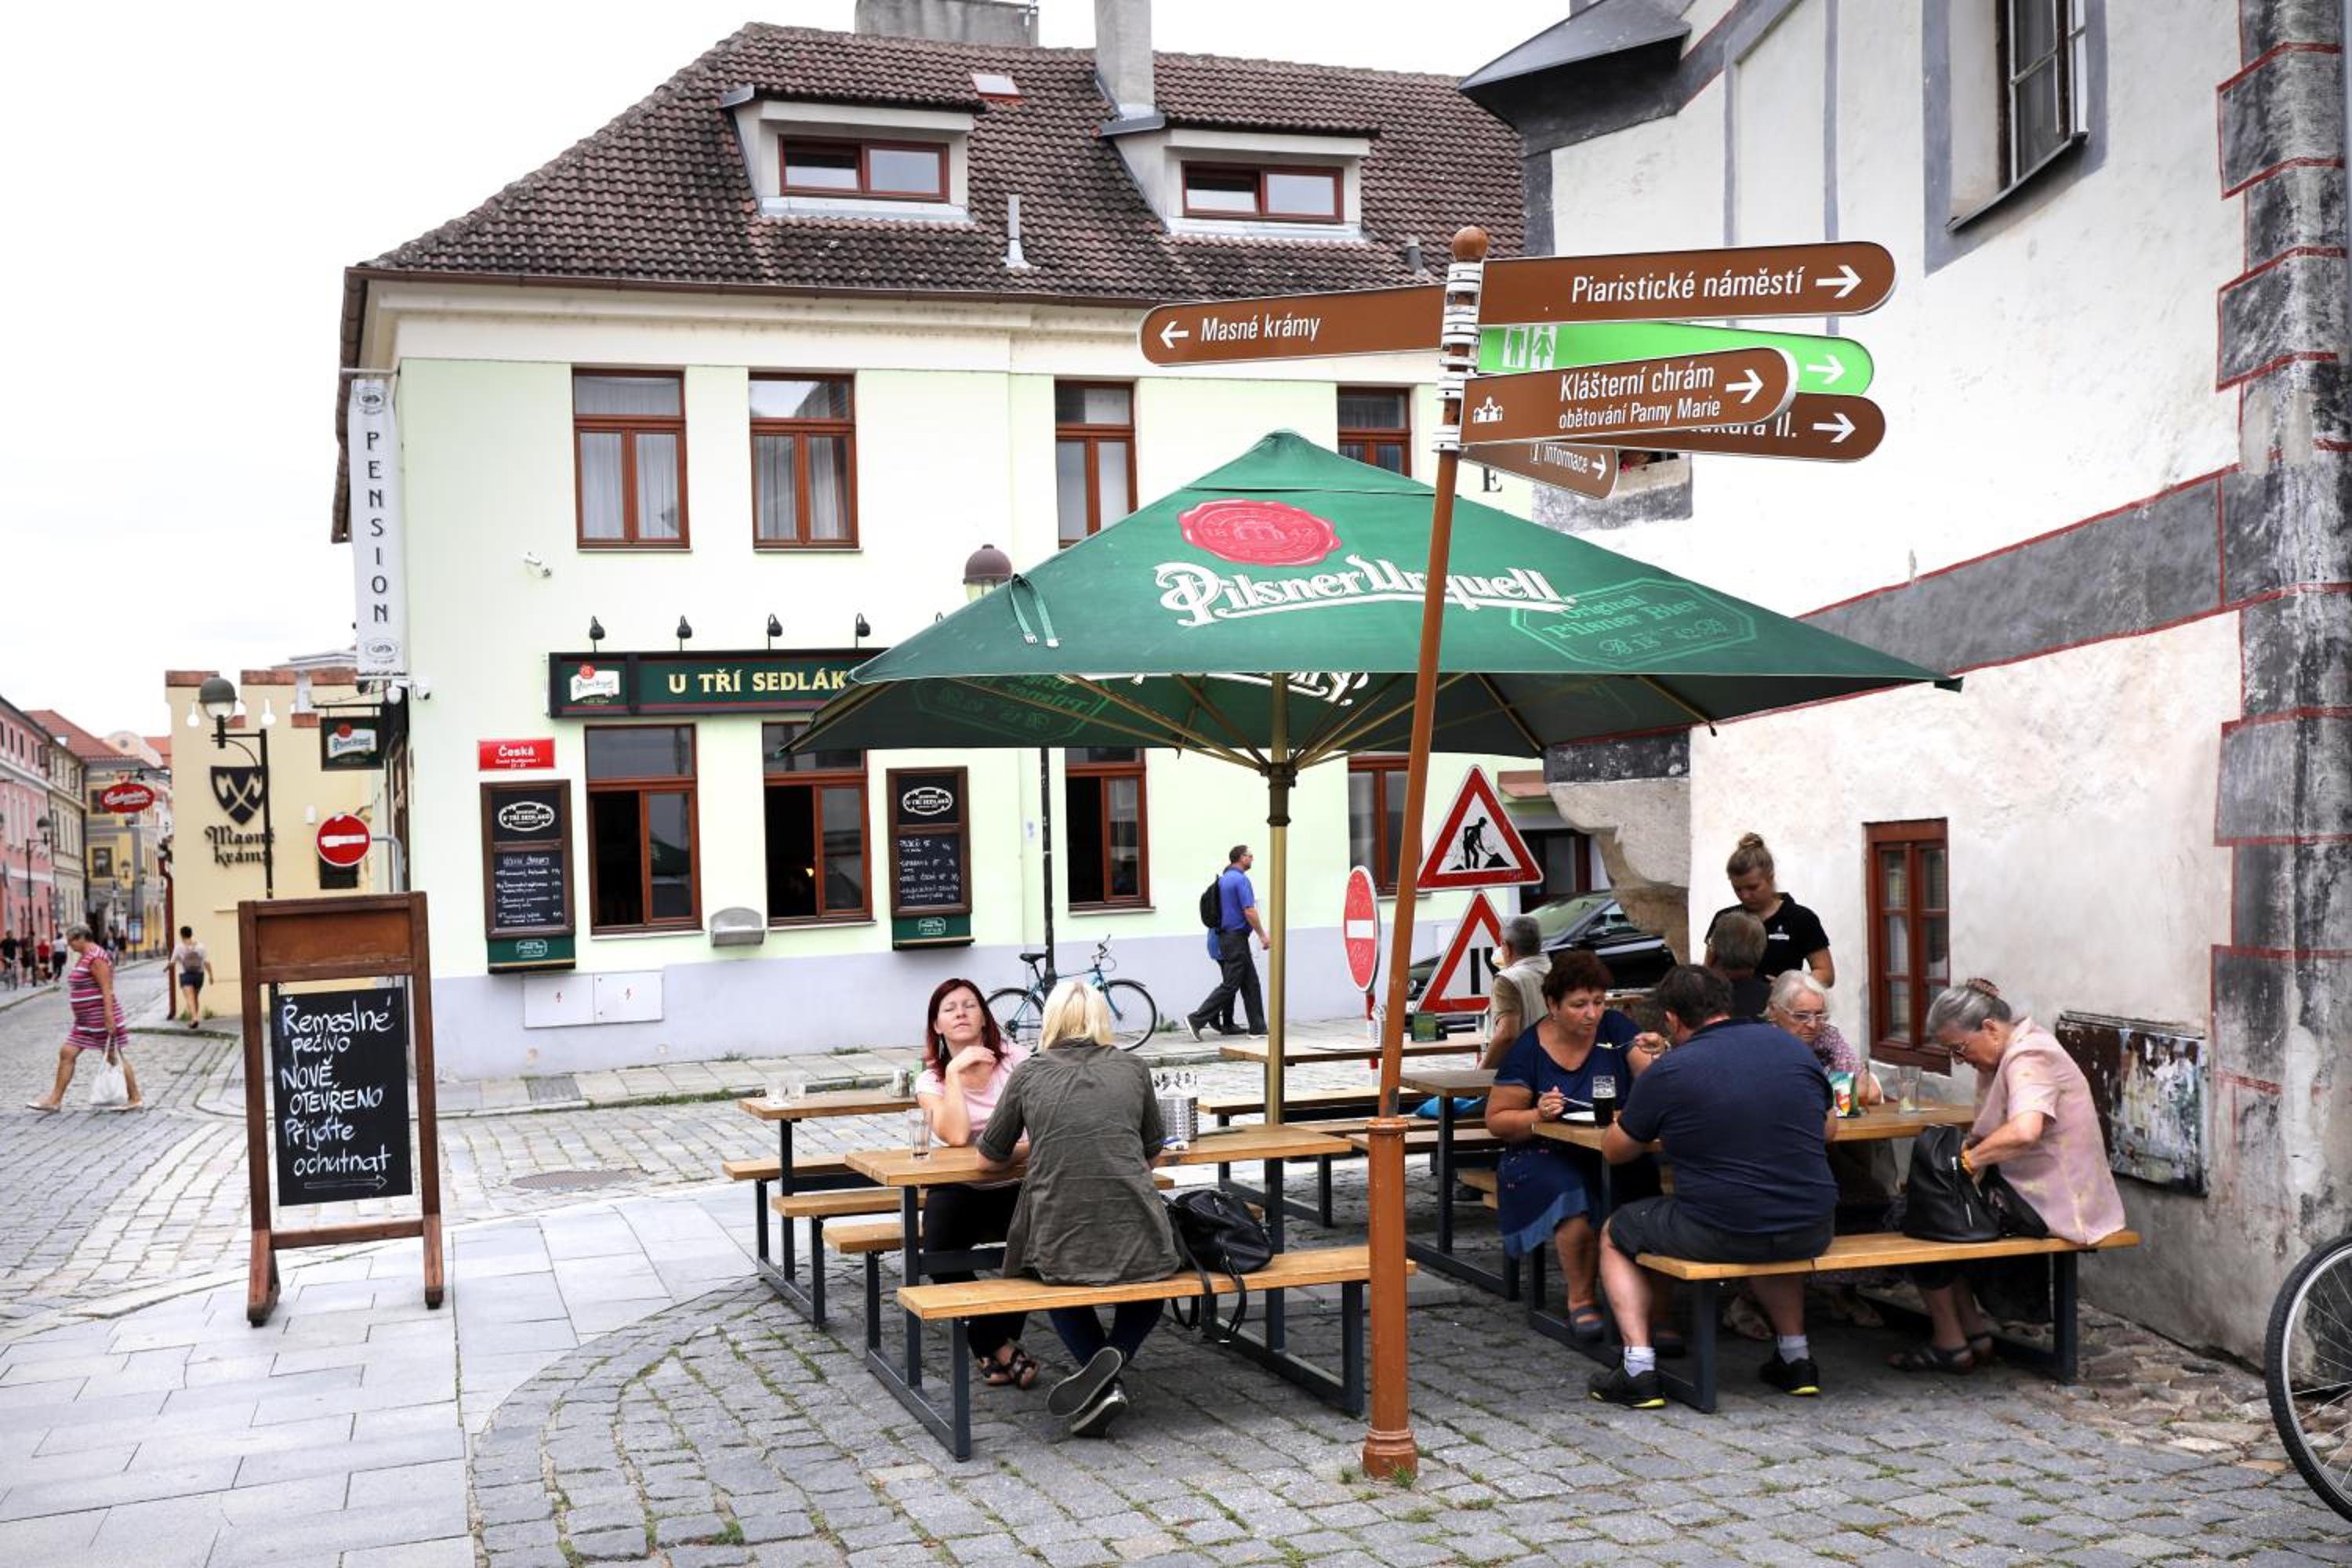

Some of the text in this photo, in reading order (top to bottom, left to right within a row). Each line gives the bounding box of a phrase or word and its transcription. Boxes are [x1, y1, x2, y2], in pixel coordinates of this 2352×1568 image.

[1571, 267, 1805, 303] Piaristické náměstí
[1201, 312, 1321, 342] Masné krámy
[1559, 361, 1715, 402] Klášterní chrám
[1559, 395, 1721, 430] obětování Panny Marie
[1544, 445, 1588, 474] Informace
[365, 432, 389, 623] PENSION
[1152, 561, 1366, 627] Pilsner
[1639, 599, 1702, 620] Bier
[669, 673, 686, 694] U
[699, 668, 743, 693] TŘÍ
[499, 744, 535, 757] Česká
[213, 846, 270, 868] krám
[282, 995, 395, 1036] Řemeslné
[291, 1033, 350, 1068] pečivo
[280, 1054, 333, 1091] NOVĚ
[293, 1143, 392, 1177] ochutnat
